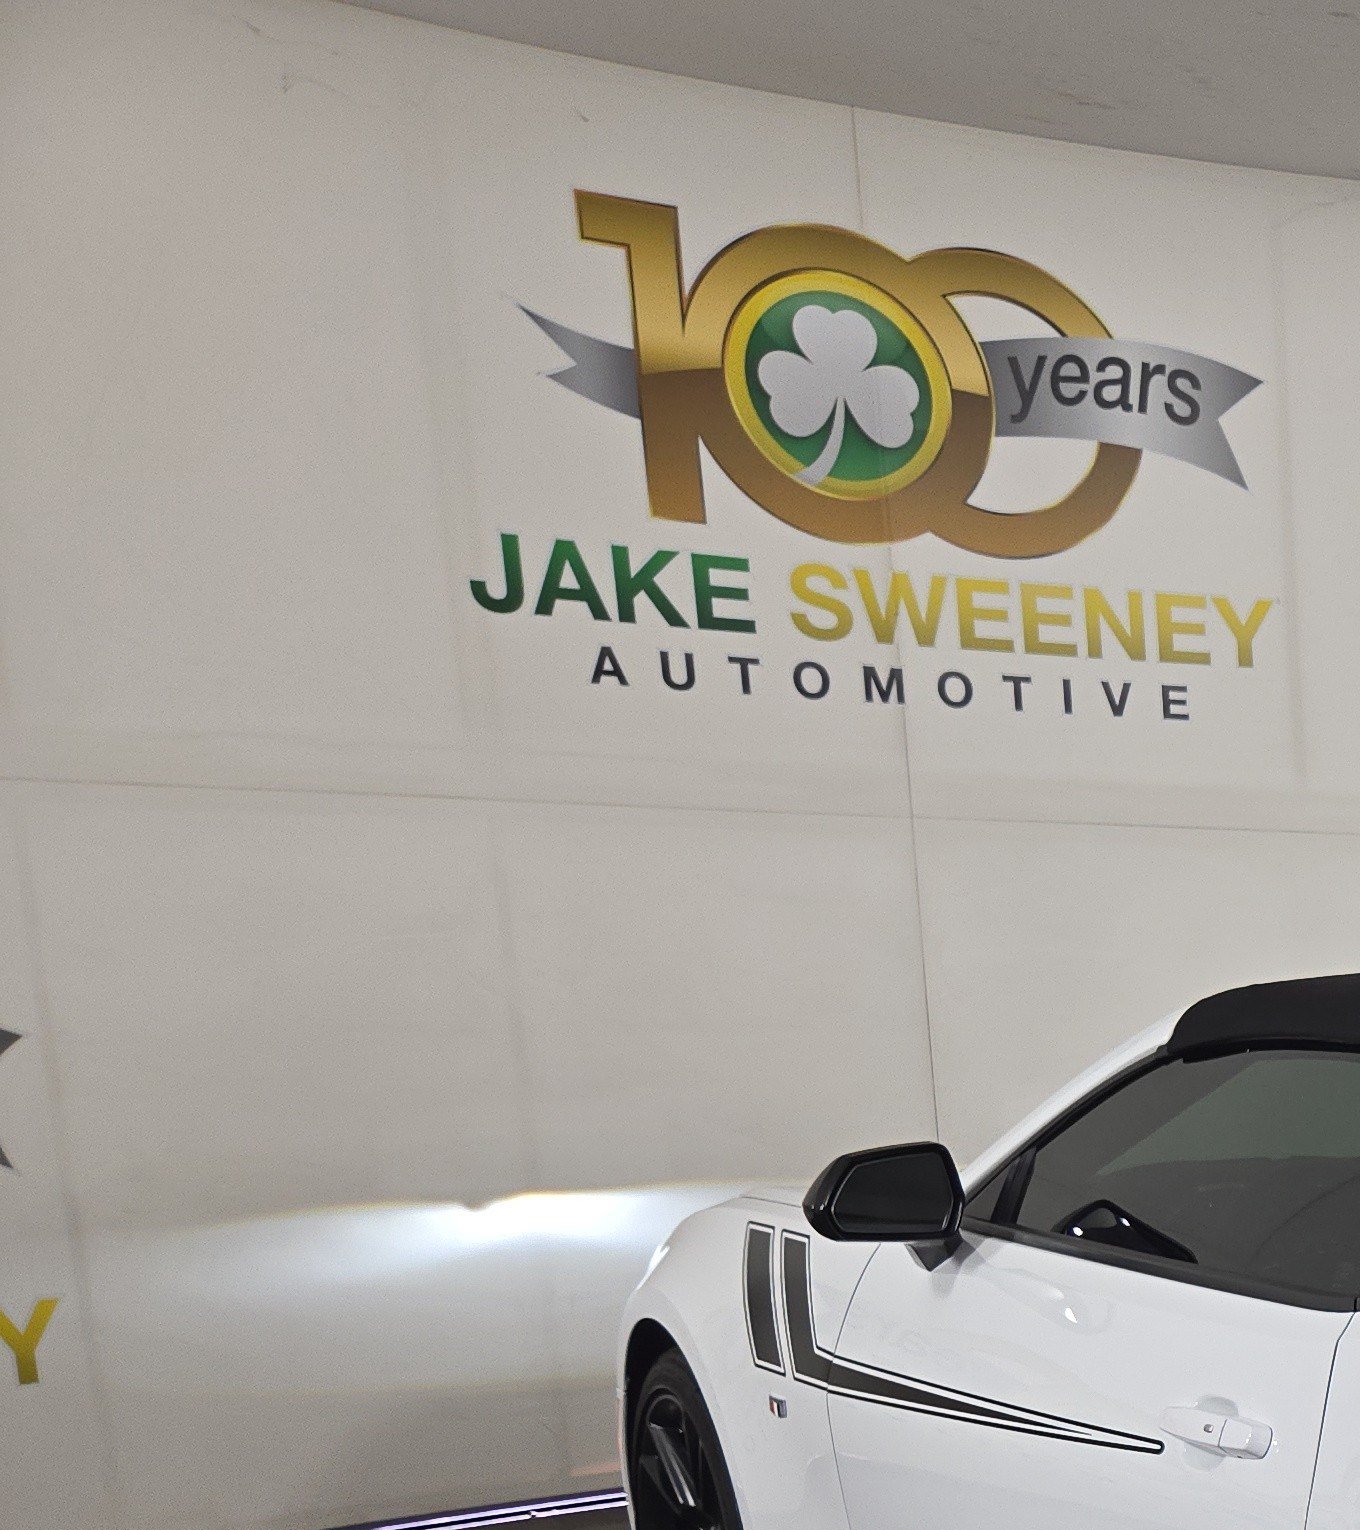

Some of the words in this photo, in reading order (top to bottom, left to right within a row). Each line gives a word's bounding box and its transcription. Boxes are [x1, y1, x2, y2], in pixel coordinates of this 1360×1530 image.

[573, 189, 1144, 559] 100
[1006, 345, 1202, 426] years
[469, 533, 757, 634] JAKE
[789, 563, 1280, 669] SWEENEY
[590, 645, 1192, 721] AUTOMOTIVE
